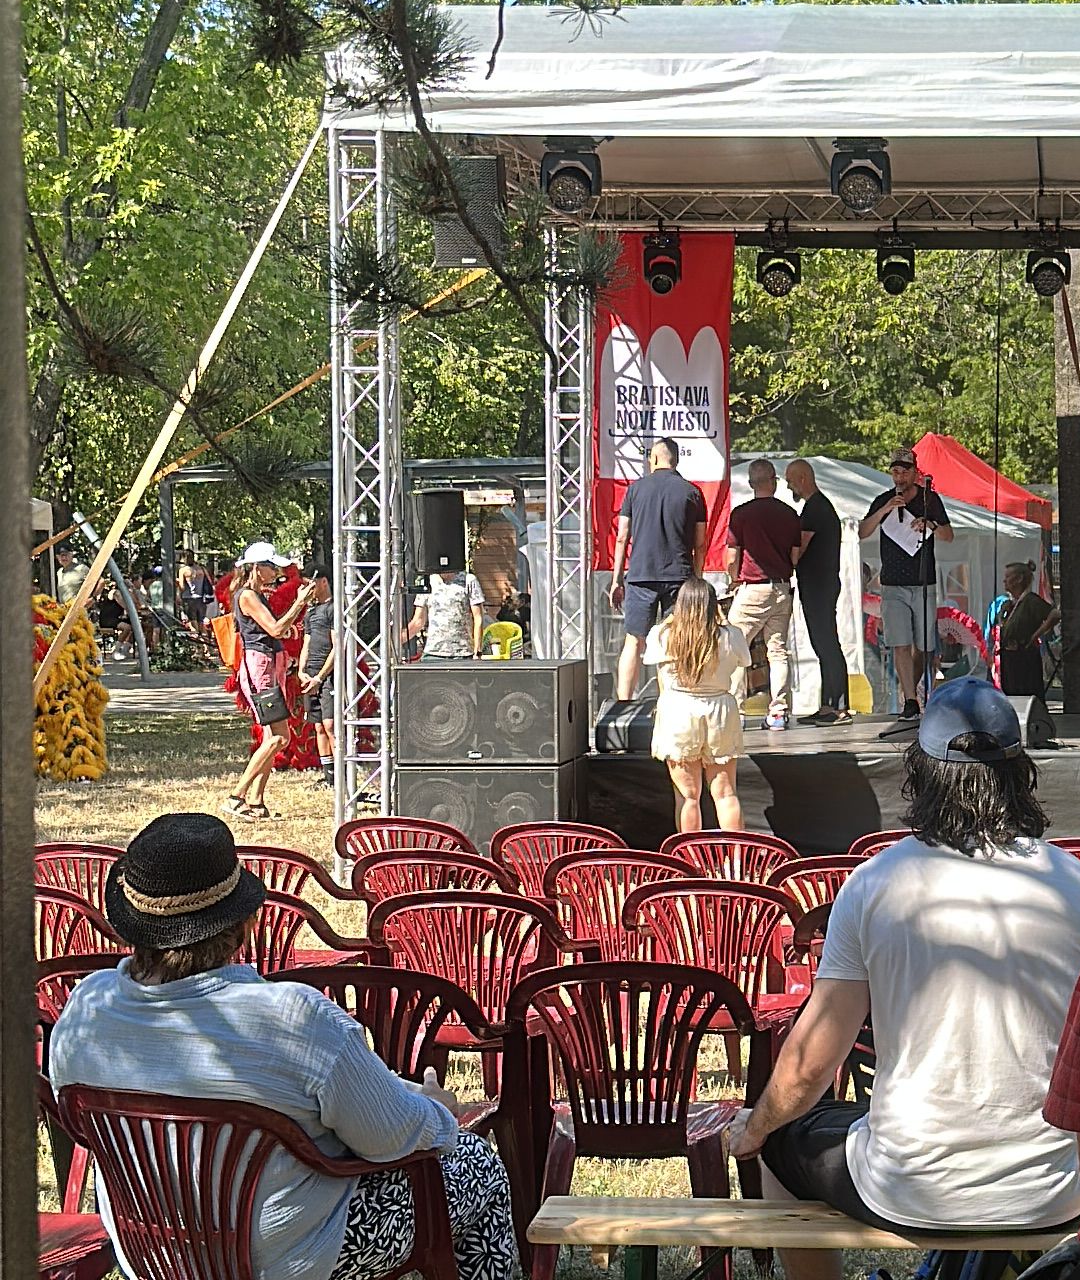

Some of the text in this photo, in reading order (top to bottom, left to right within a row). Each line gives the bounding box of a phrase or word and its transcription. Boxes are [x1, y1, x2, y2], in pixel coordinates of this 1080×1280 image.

[616, 384, 710, 407] BRATISLAVA
[616, 407, 710, 431] NOVÉ MESTO
